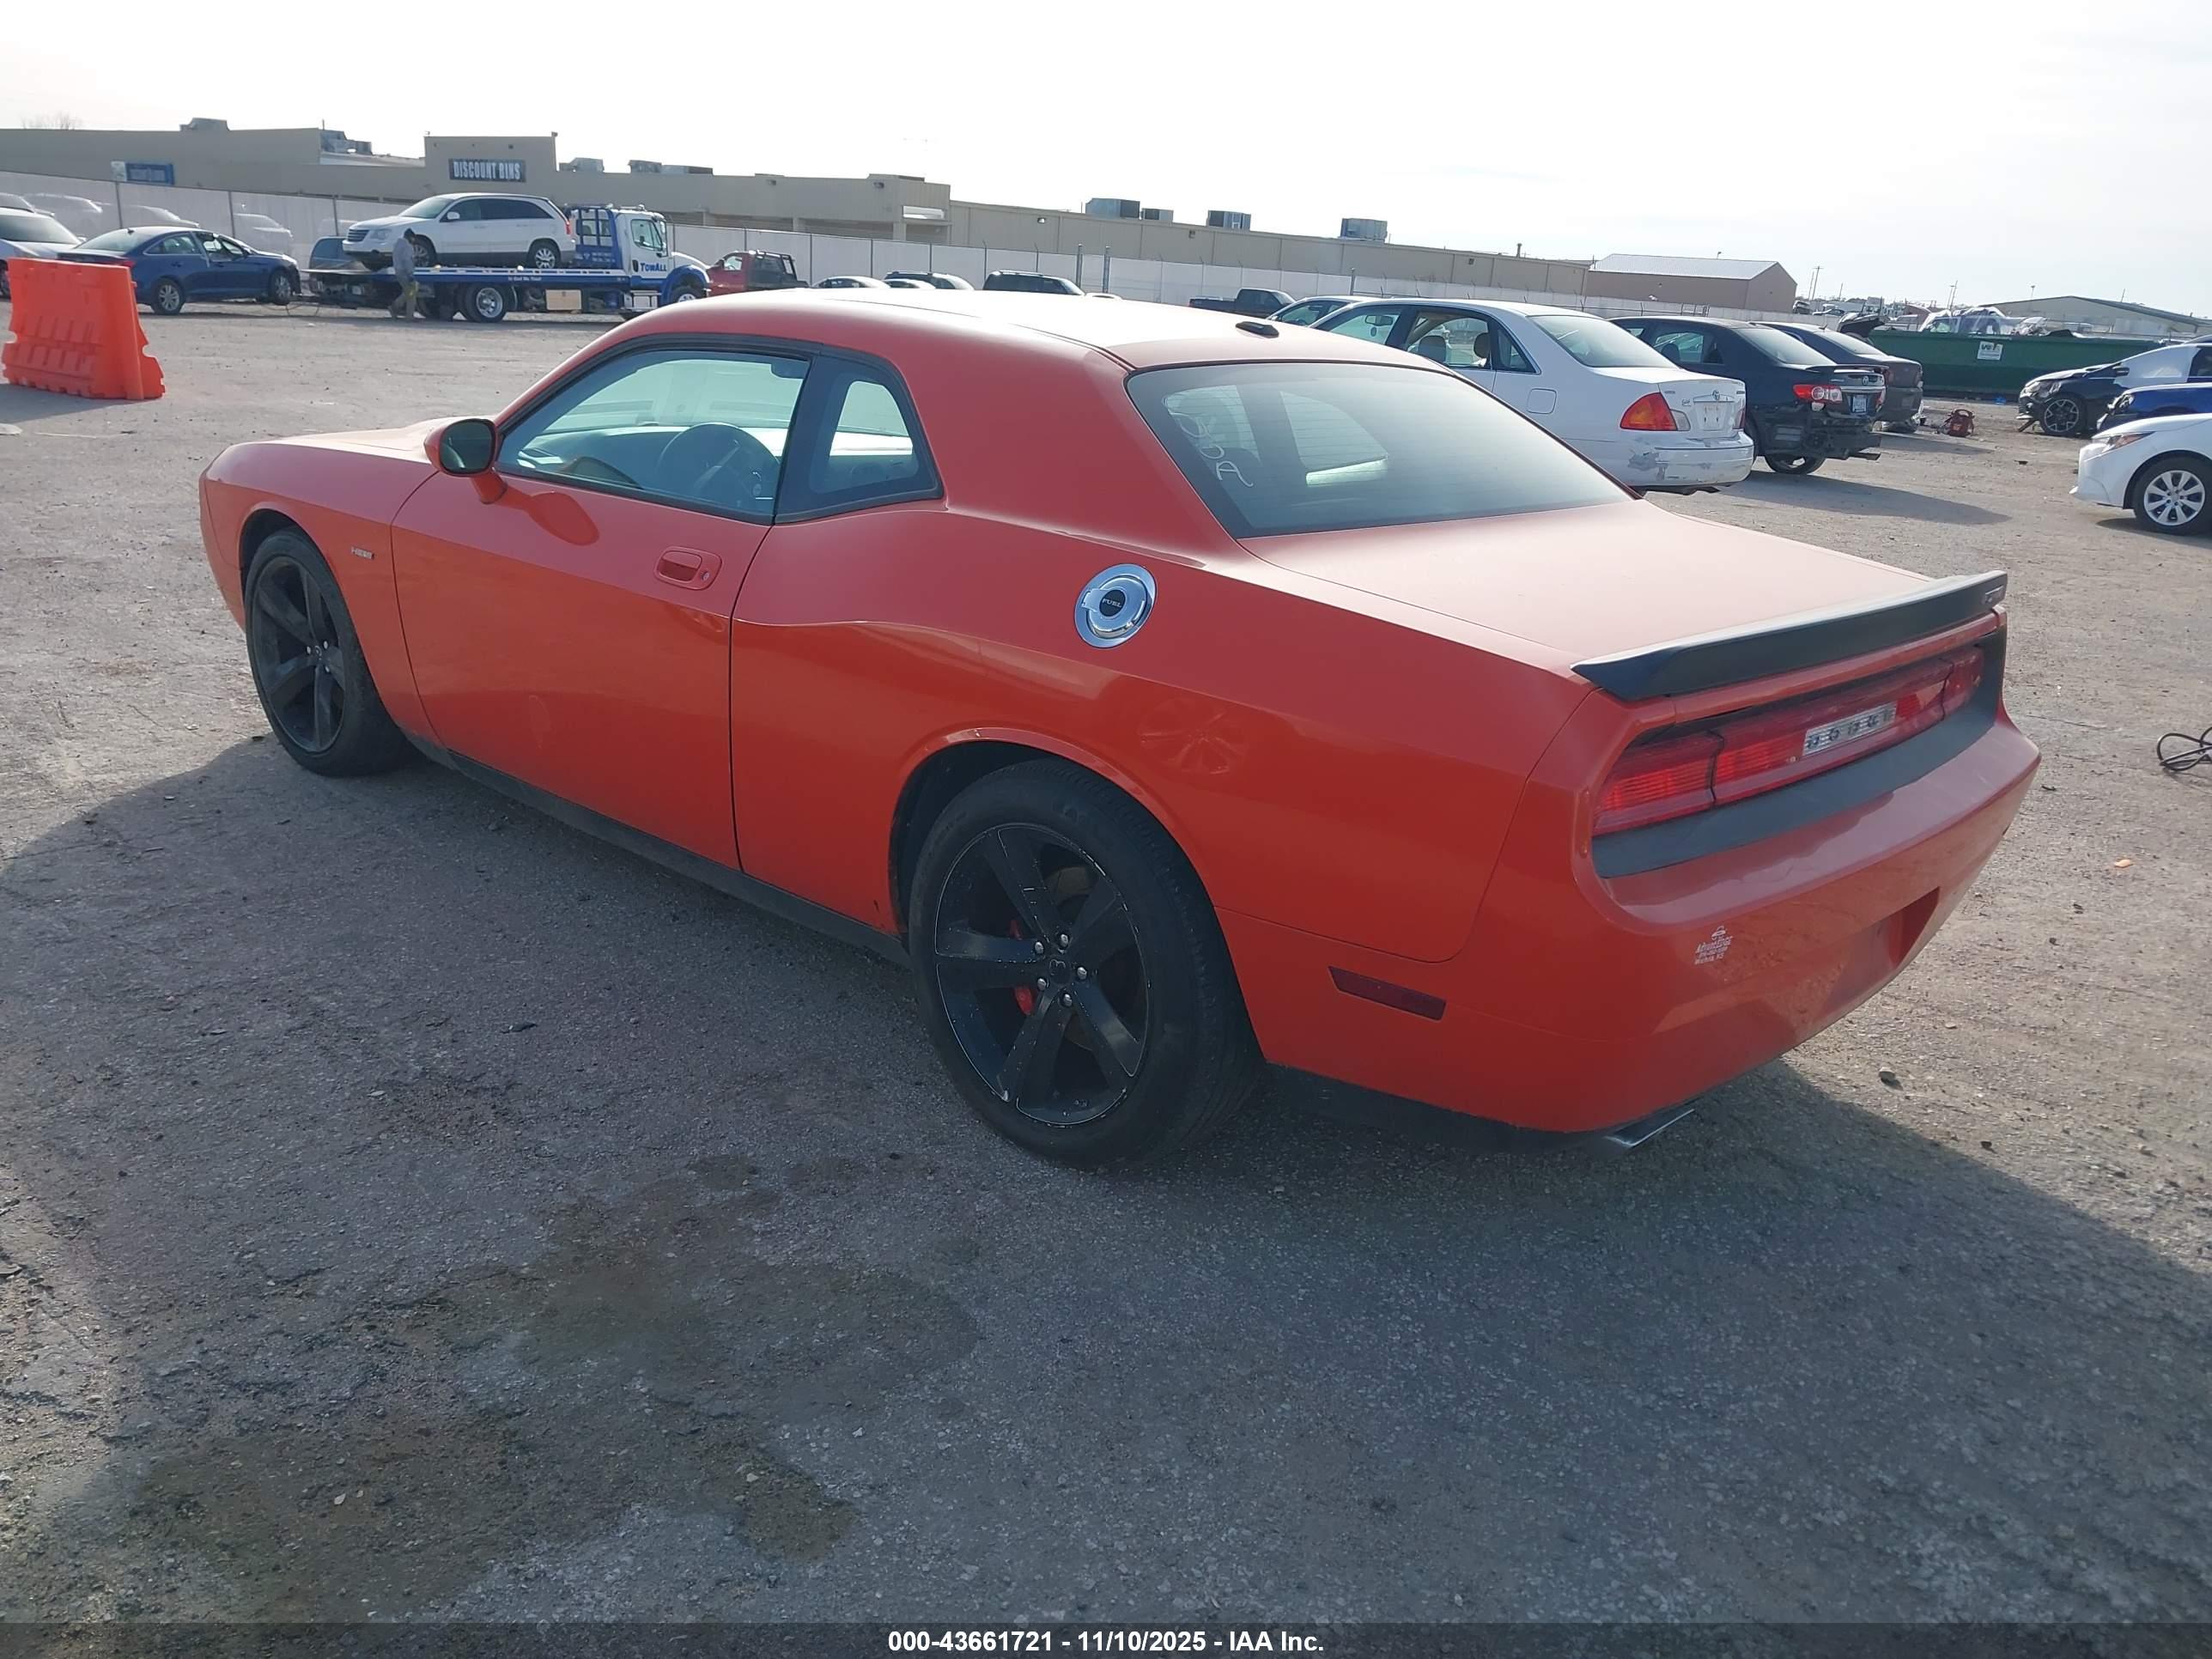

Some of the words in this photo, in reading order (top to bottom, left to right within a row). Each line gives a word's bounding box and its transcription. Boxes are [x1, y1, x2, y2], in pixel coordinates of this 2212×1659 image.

[453, 161, 497, 179] DISCOUNT
[499, 162, 520, 179] BINS
[1102, 598, 1122, 608] FUEL
